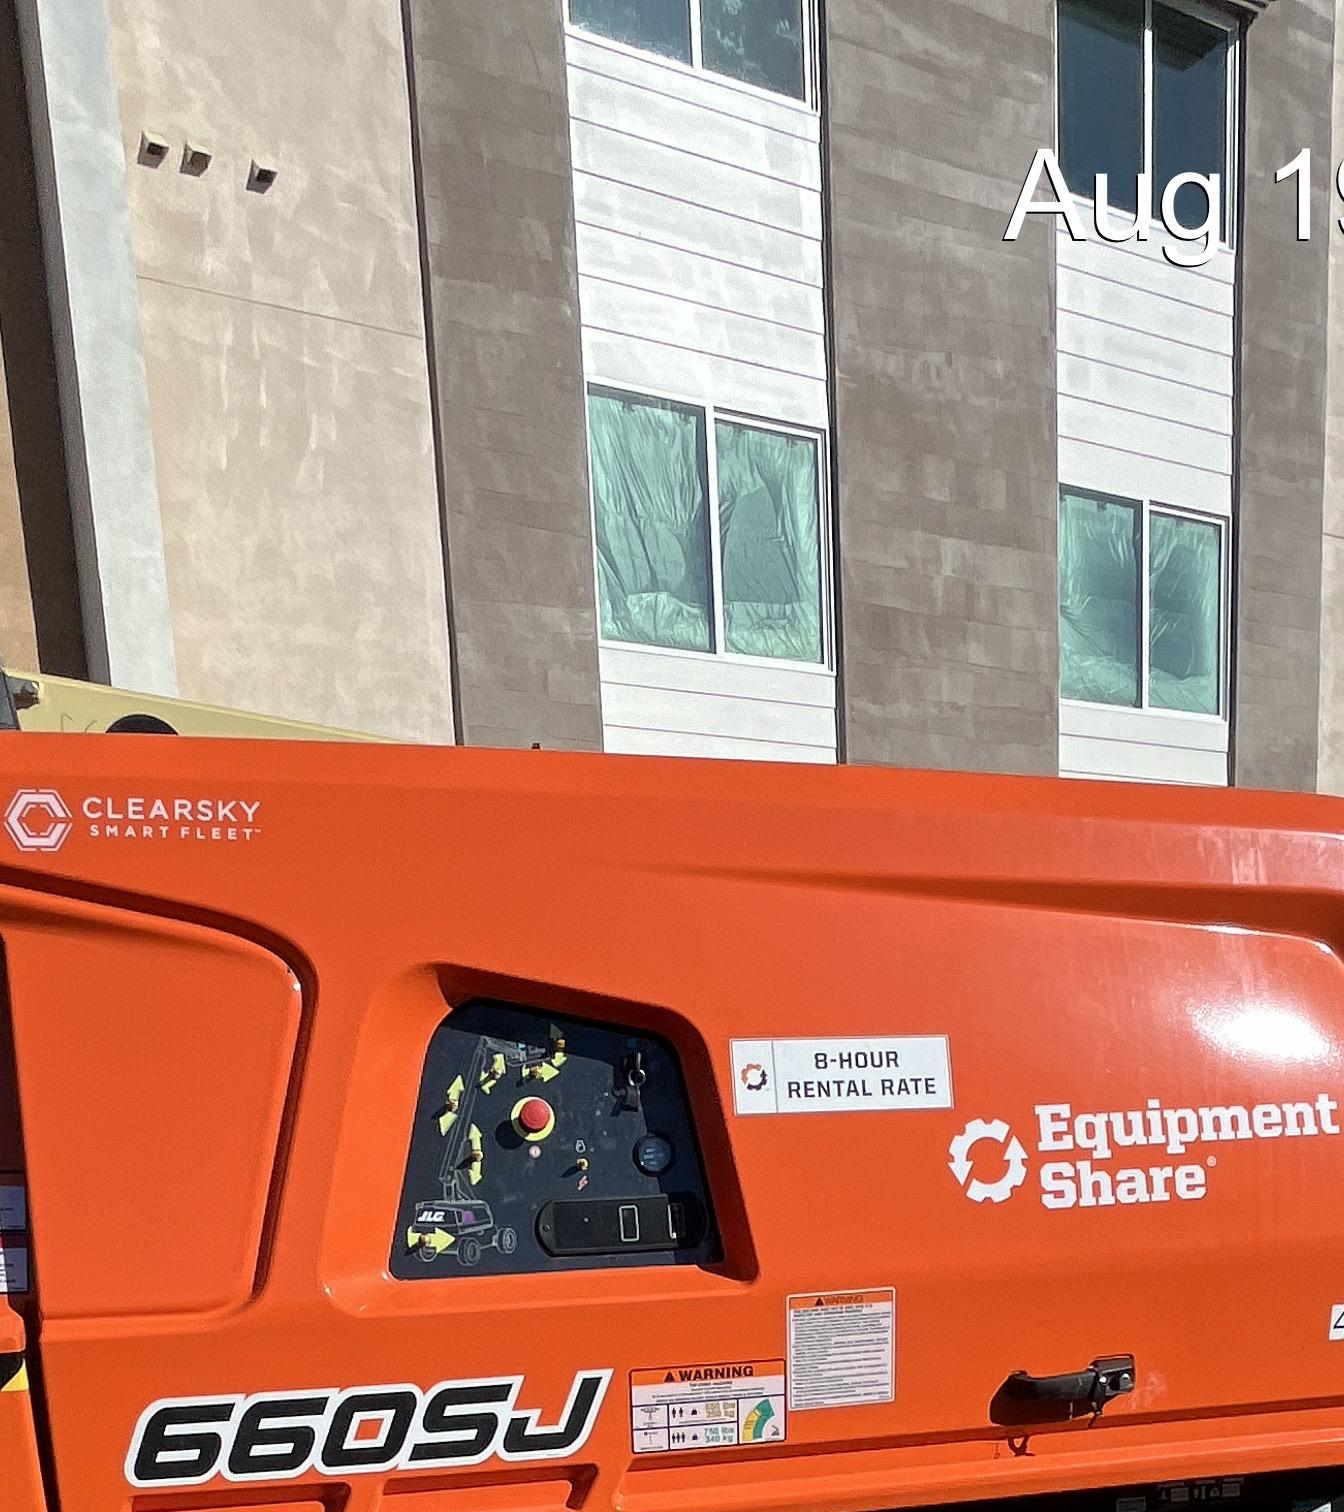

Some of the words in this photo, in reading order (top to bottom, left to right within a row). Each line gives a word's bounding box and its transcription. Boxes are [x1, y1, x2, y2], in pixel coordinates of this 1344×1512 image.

[81, 796, 262, 823] CLEARSKY
[88, 823, 169, 839] SMART
[180, 825, 255, 841] FLEET
[813, 1050, 900, 1070] 8-HOUR
[787, 1079, 874, 1099] RENTAL
[880, 1077, 938, 1097] RATE
[1033, 1092, 1341, 1160] Equipment
[1039, 1159, 1208, 1210] Share
[417, 1210, 446, 1223] JLG
[677, 1364, 754, 1382] WARNING
[127, 1369, 612, 1487] 660SJ
